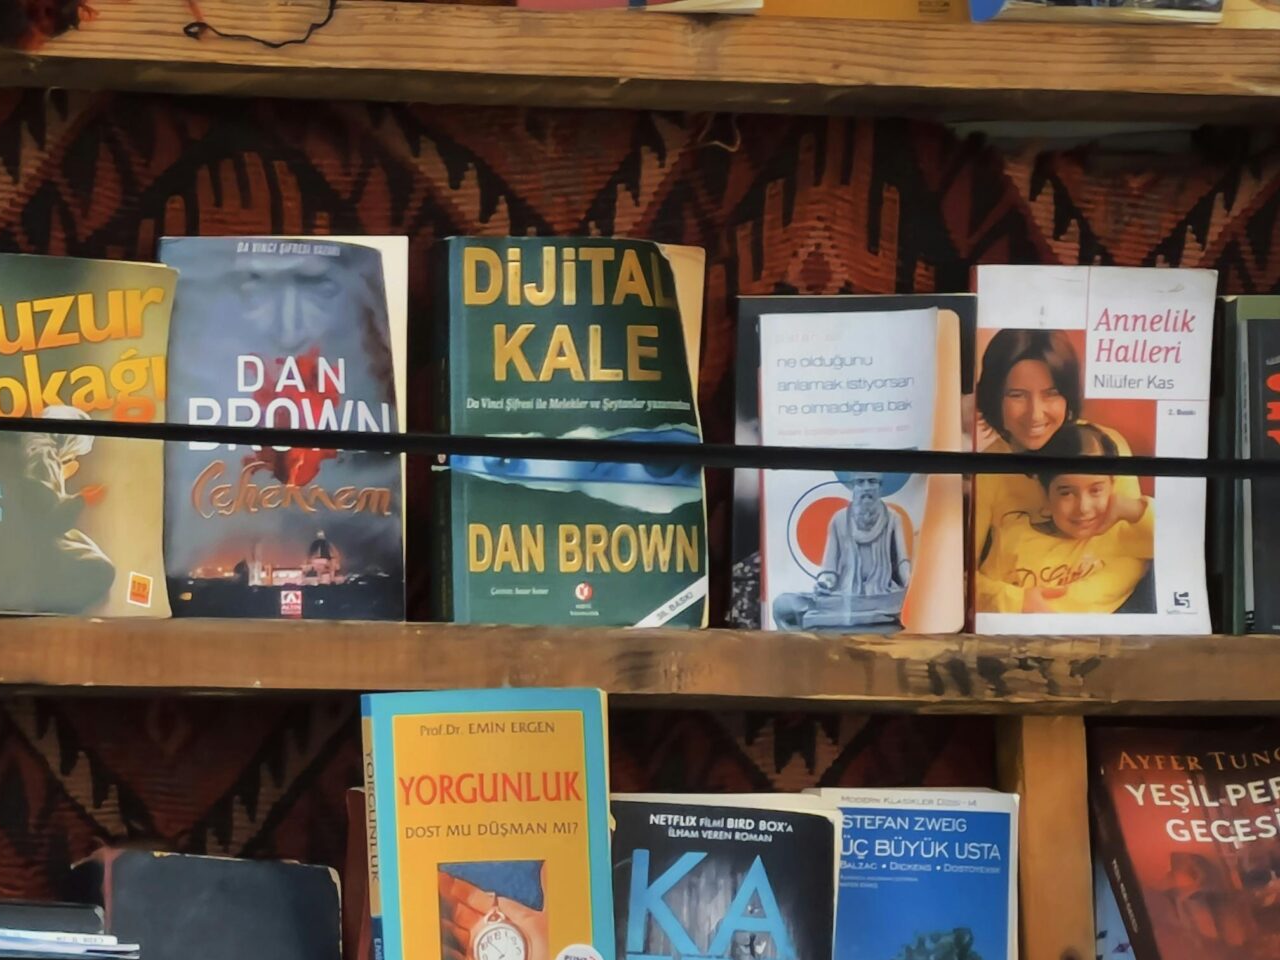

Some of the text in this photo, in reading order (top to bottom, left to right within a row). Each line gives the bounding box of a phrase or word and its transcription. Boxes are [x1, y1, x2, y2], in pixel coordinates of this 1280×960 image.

[463, 246, 676, 308] DİJİTAL
[1093, 308, 1196, 332] Annelik
[494, 324, 662, 382] KALE
[777, 355, 873, 370] ne olduğunu
[1095, 339, 1182, 364] Halleri
[238, 355, 345, 394] DAN
[777, 376, 914, 392] anlamak istiyorsan
[1147, 376, 1175, 389] Kas
[466, 398, 479, 408] Da
[481, 398, 503, 408] Vinci
[779, 403, 798, 415] ne
[888, 401, 912, 412] bak
[188, 397, 391, 454] BROWN
[191, 460, 392, 519] Cehennem
[469, 523, 698, 574] DAN BROWN
[468, 721, 506, 735] EMİN
[511, 721, 556, 734] ERGEN
[1119, 751, 1204, 771] AYFER
[399, 771, 582, 806] YORGUNLUK
[1125, 779, 1219, 813] YEŞİL
[404, 821, 579, 839] DOST MU DÜŞMAN MI?
[649, 814, 793, 833] NETFLIX FİLMİ BIRD BOX'A
[667, 827, 773, 842] İLHAM VEREN ROMAN
[842, 815, 967, 832] STEFAN ZWEIG
[842, 835, 1001, 860] ÜÇ BÜYÜK USTA
[627, 848, 797, 956] KA
